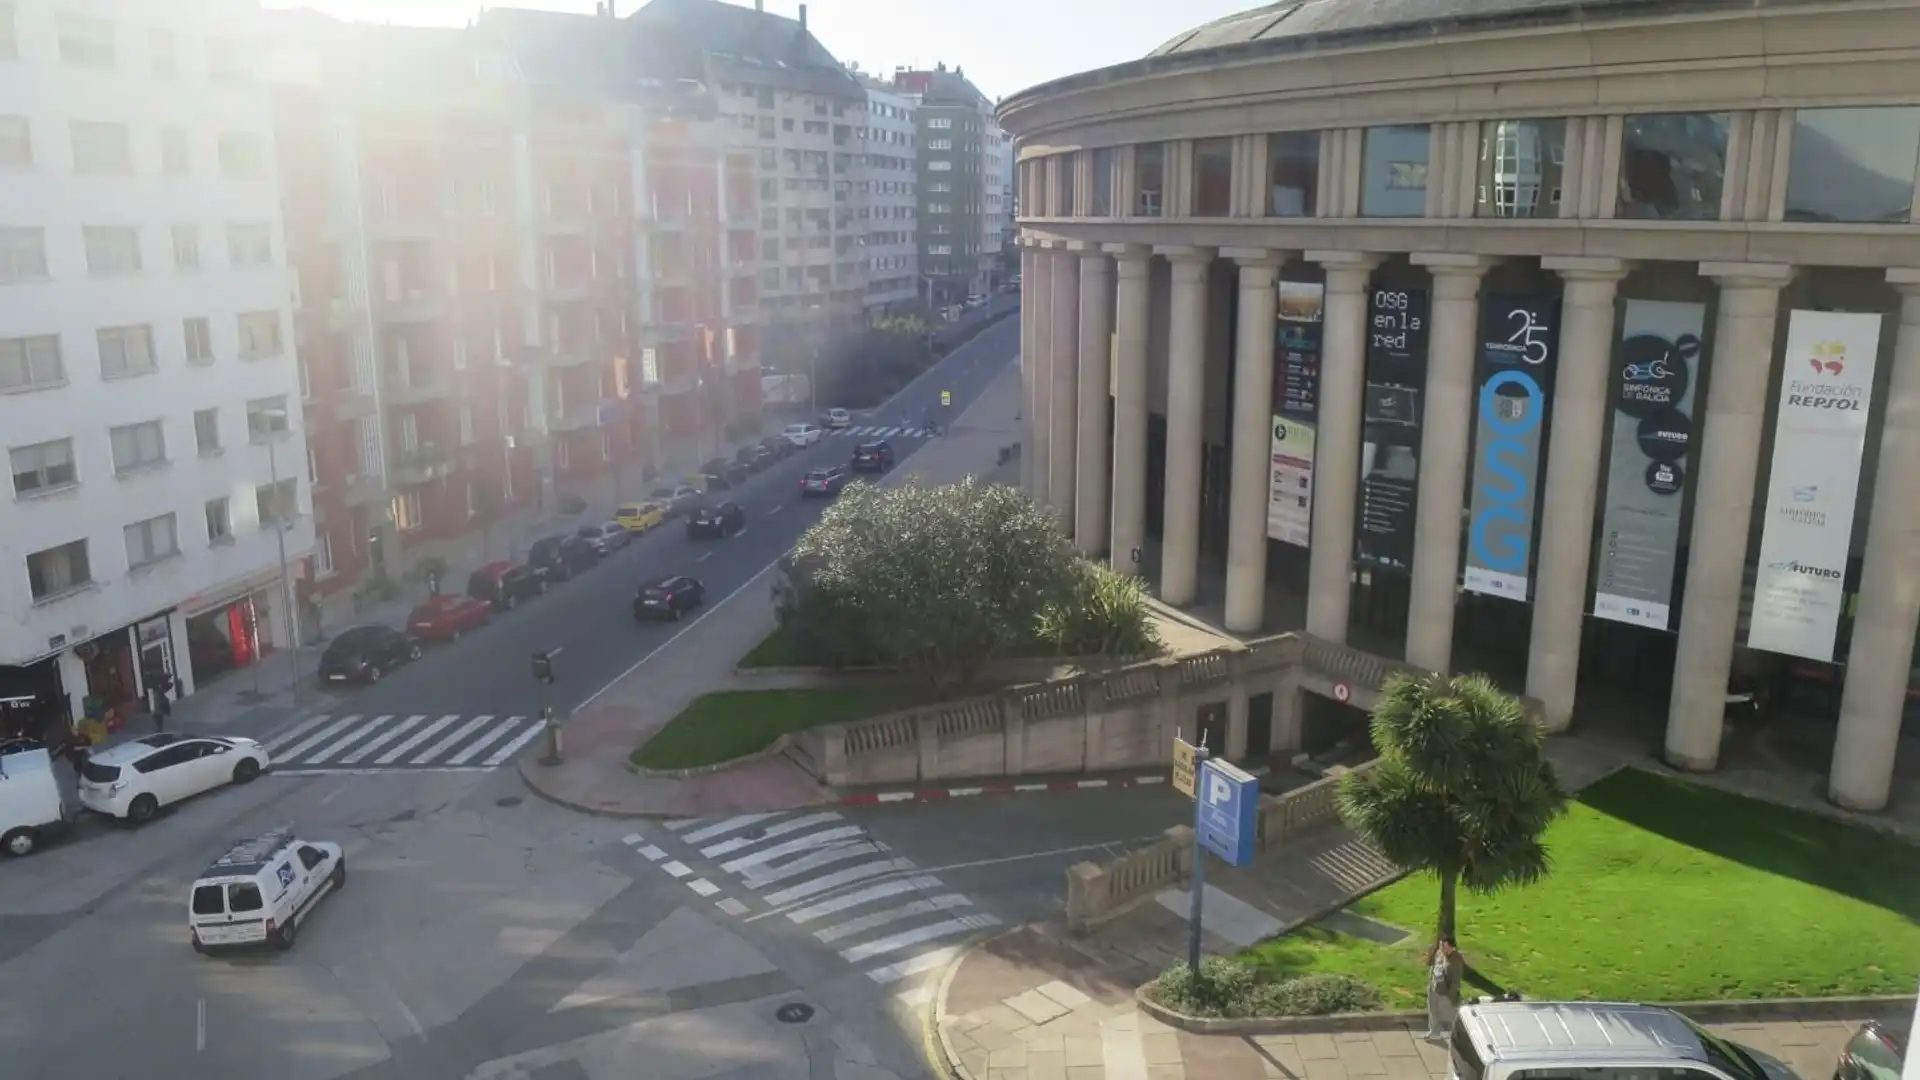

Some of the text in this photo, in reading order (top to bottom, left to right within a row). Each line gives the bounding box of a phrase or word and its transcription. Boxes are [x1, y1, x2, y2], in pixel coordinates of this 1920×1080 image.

[1376, 290, 1408, 309] OSG
[1374, 311, 1421, 330] en la
[1373, 331, 1406, 349] red
[1508, 309, 1548, 364] 25
[1790, 379, 1862, 397] Fundación
[1788, 394, 1861, 411] REPSOL
[1794, 564, 1842, 580] FUTURO
[1209, 773, 1231, 807] P
